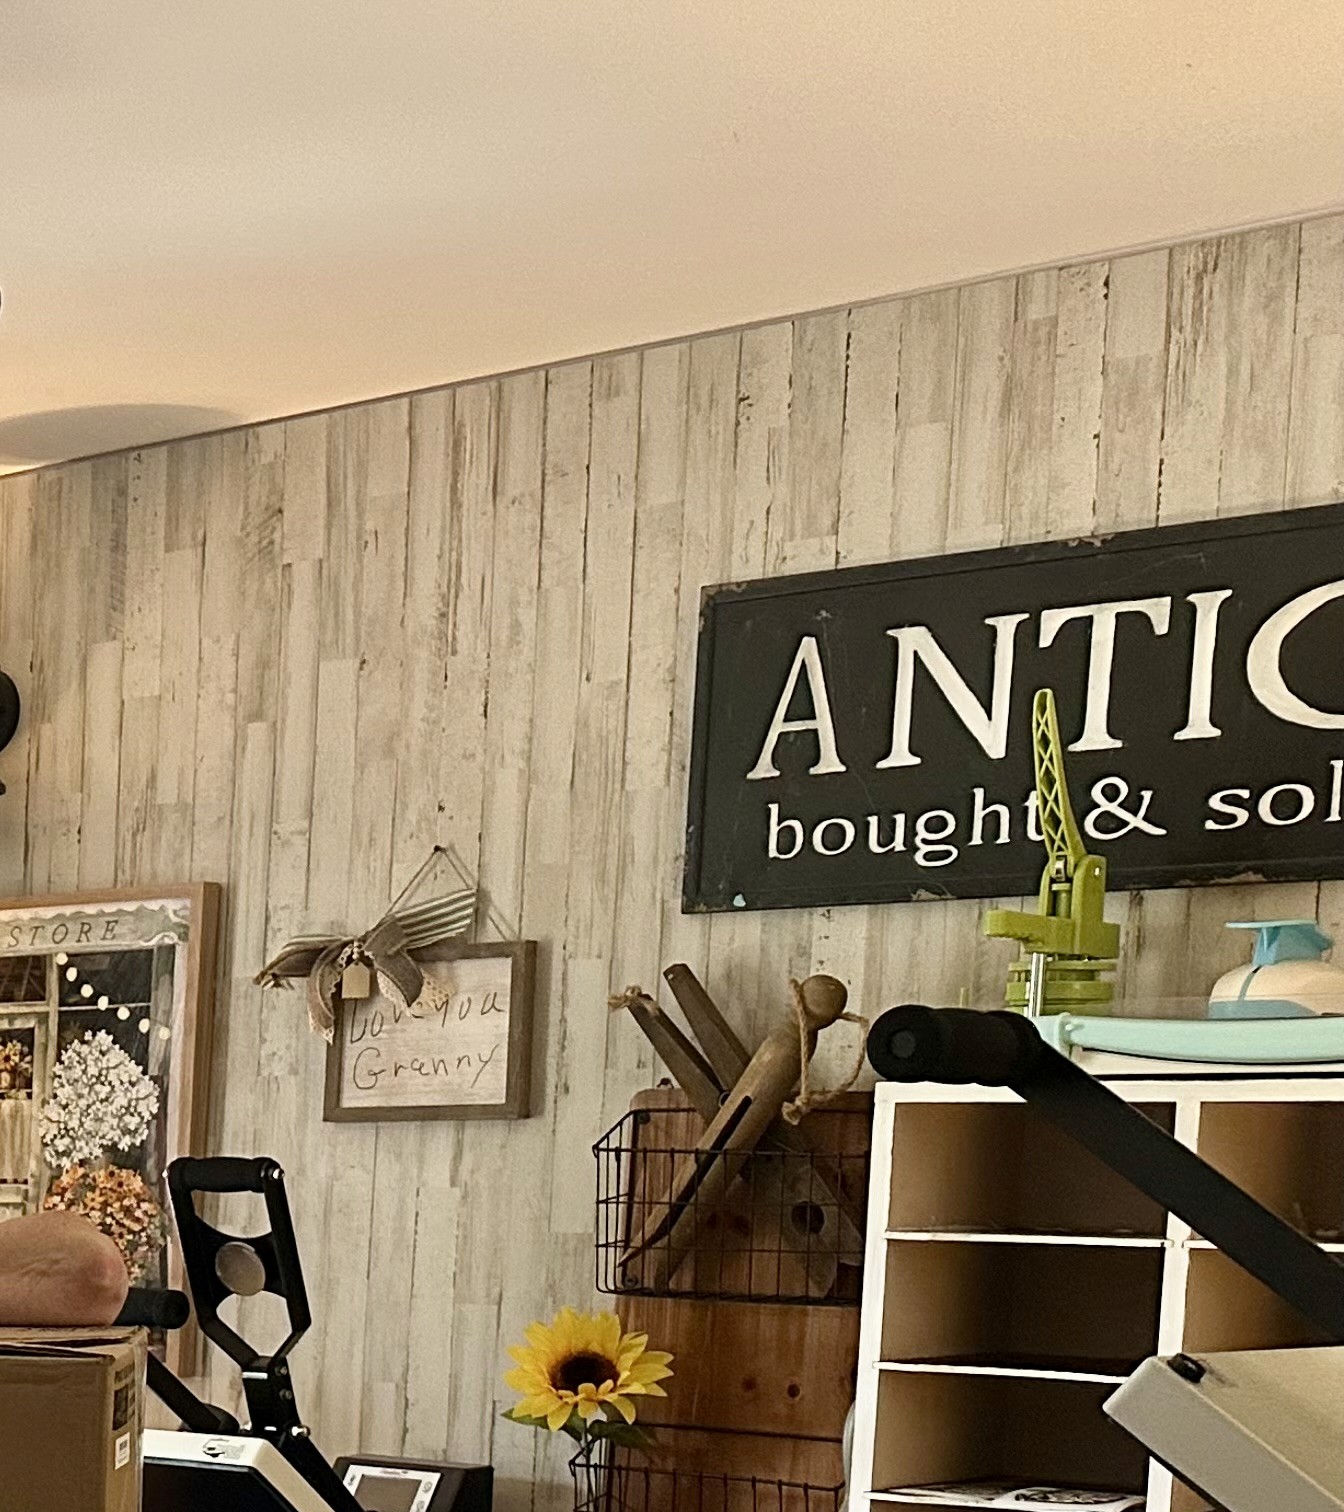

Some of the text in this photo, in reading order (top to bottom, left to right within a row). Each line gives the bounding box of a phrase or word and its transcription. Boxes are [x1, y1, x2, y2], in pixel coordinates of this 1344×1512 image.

[767, 786, 1048, 867] bought
[1083, 776, 1168, 840] &
[7, 919, 120, 949] STORE
[433, 991, 505, 1028] you
[352, 1042, 500, 1091] Granny
